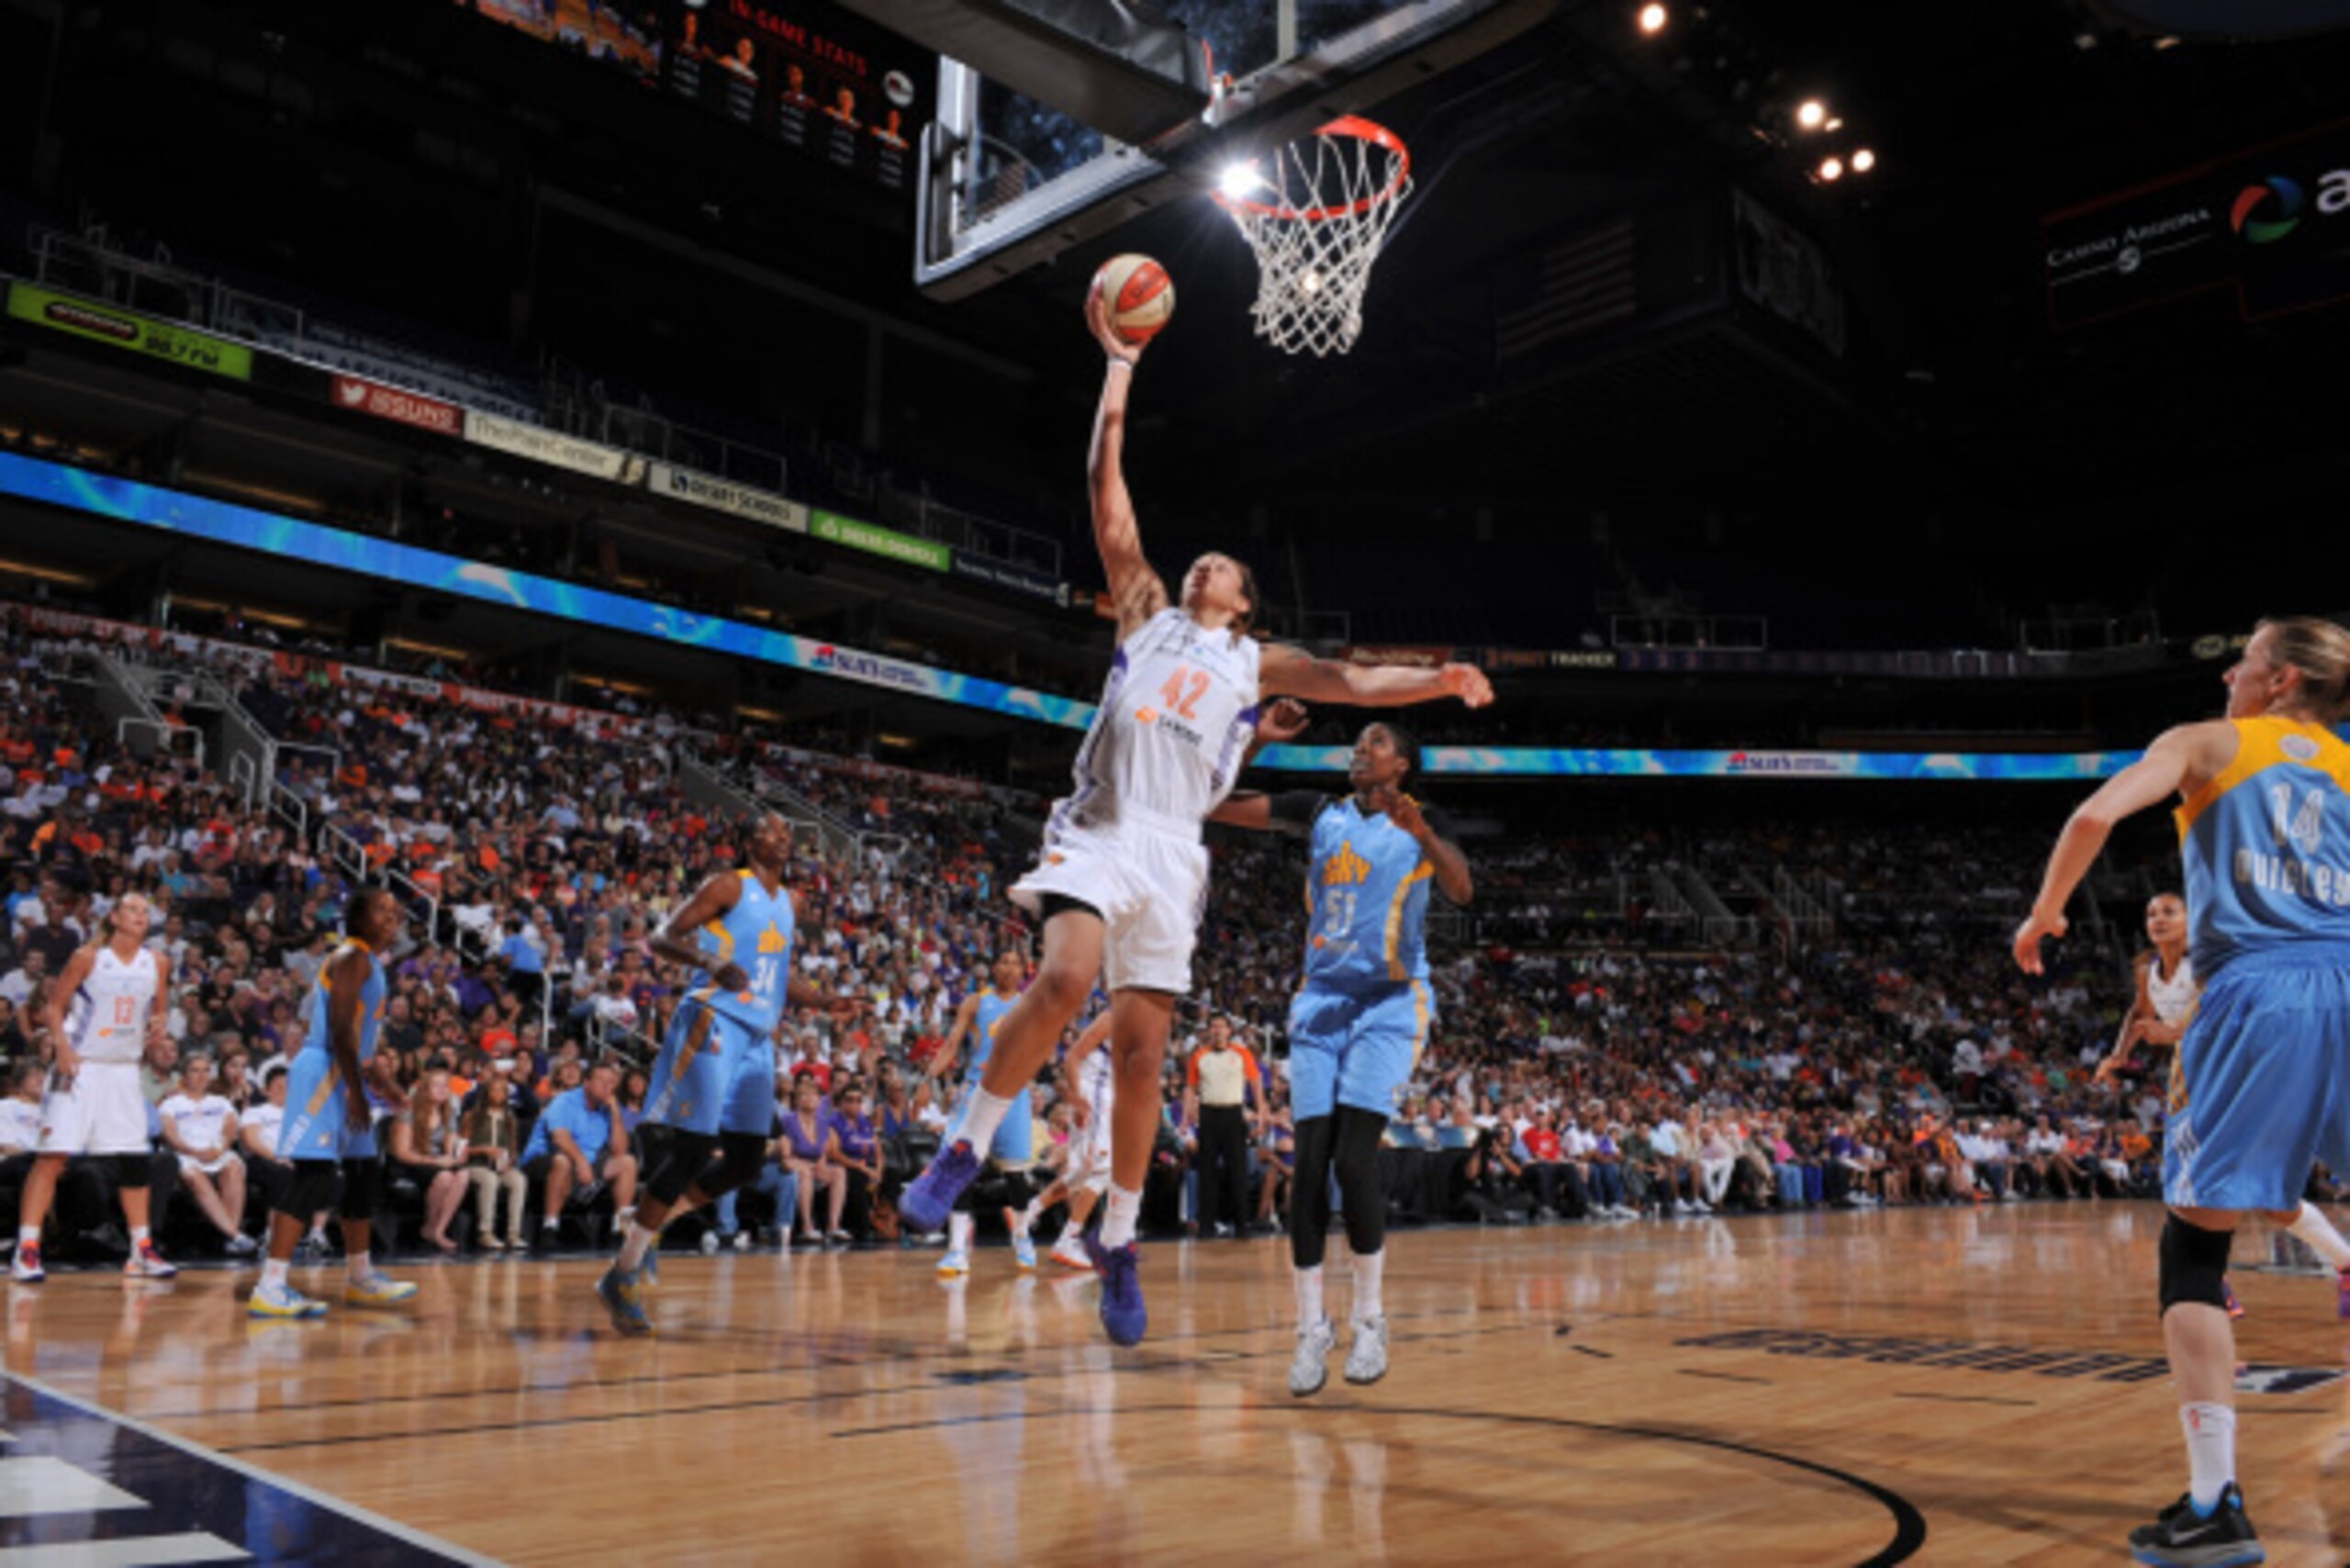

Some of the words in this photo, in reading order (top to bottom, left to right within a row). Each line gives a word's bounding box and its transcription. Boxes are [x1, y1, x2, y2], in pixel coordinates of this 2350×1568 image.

[813, 35, 867, 76] STATS
[1160, 664, 1212, 720] 42
[2272, 782, 2325, 855] 14
